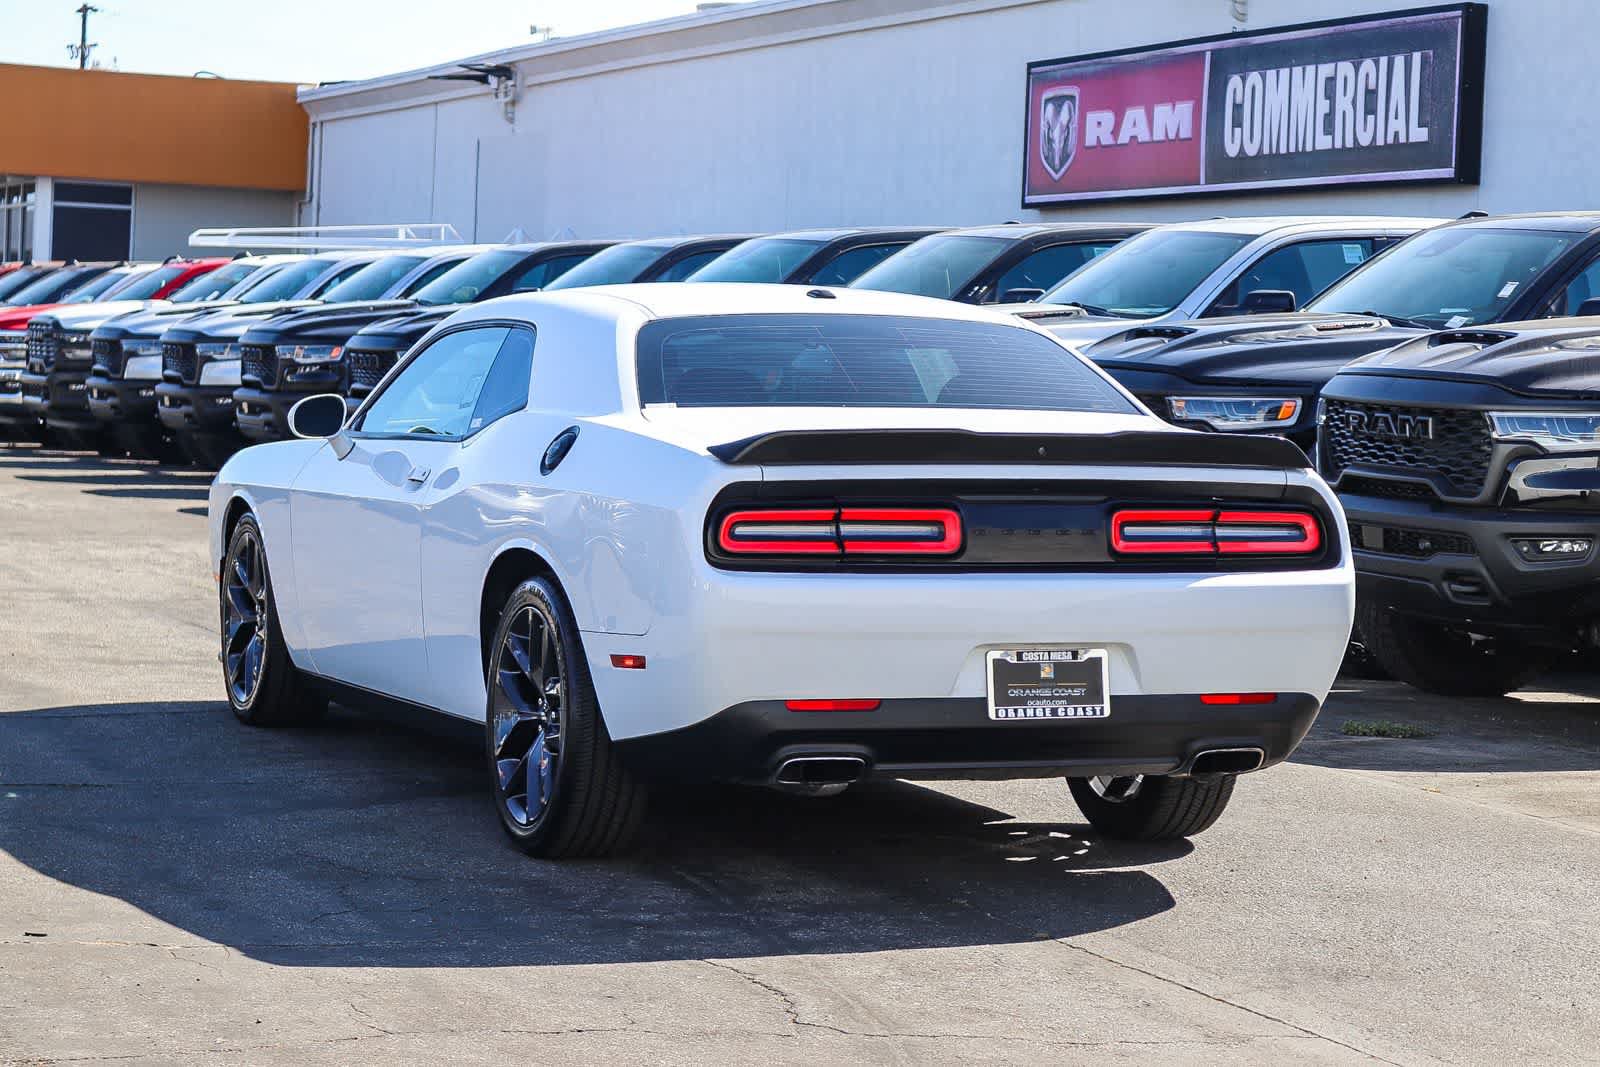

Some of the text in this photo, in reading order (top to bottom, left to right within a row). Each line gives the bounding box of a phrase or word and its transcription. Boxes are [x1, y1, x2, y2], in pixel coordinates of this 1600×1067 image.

[1224, 50, 1430, 158] COMMERCIAL
[1084, 101, 1195, 148] RAM
[1344, 409, 1433, 439] RAM
[1022, 651, 1073, 661] COSTA MESA
[1008, 687, 1087, 697] ORANGE COAST
[1027, 699, 1068, 707] ocauto.com
[998, 706, 1103, 718] ORANGE COAST
